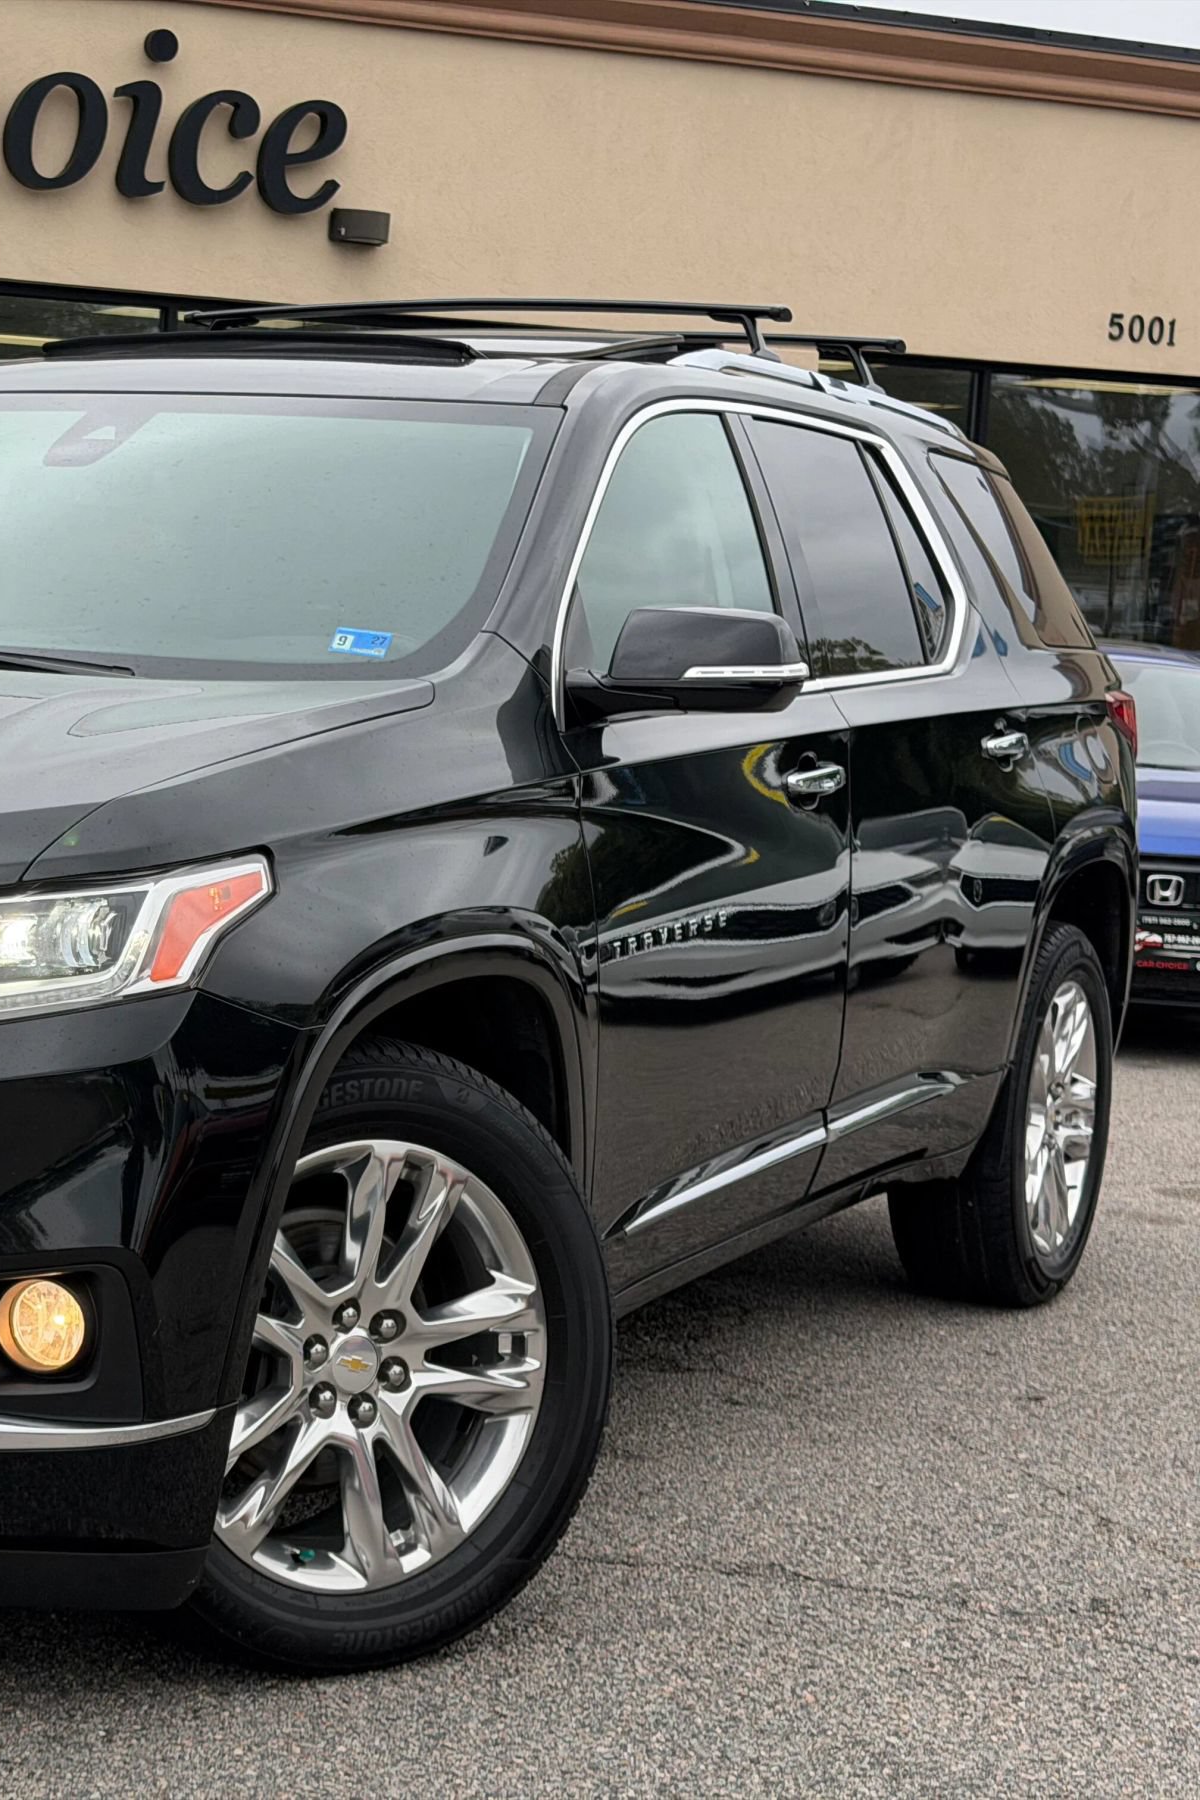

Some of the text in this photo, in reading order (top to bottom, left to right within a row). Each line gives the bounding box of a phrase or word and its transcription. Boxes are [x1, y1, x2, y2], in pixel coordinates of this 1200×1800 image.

[1108, 313, 1177, 347] 5001
[337, 635, 348, 647] 9
[613, 910, 728, 960] TRAVERSE
